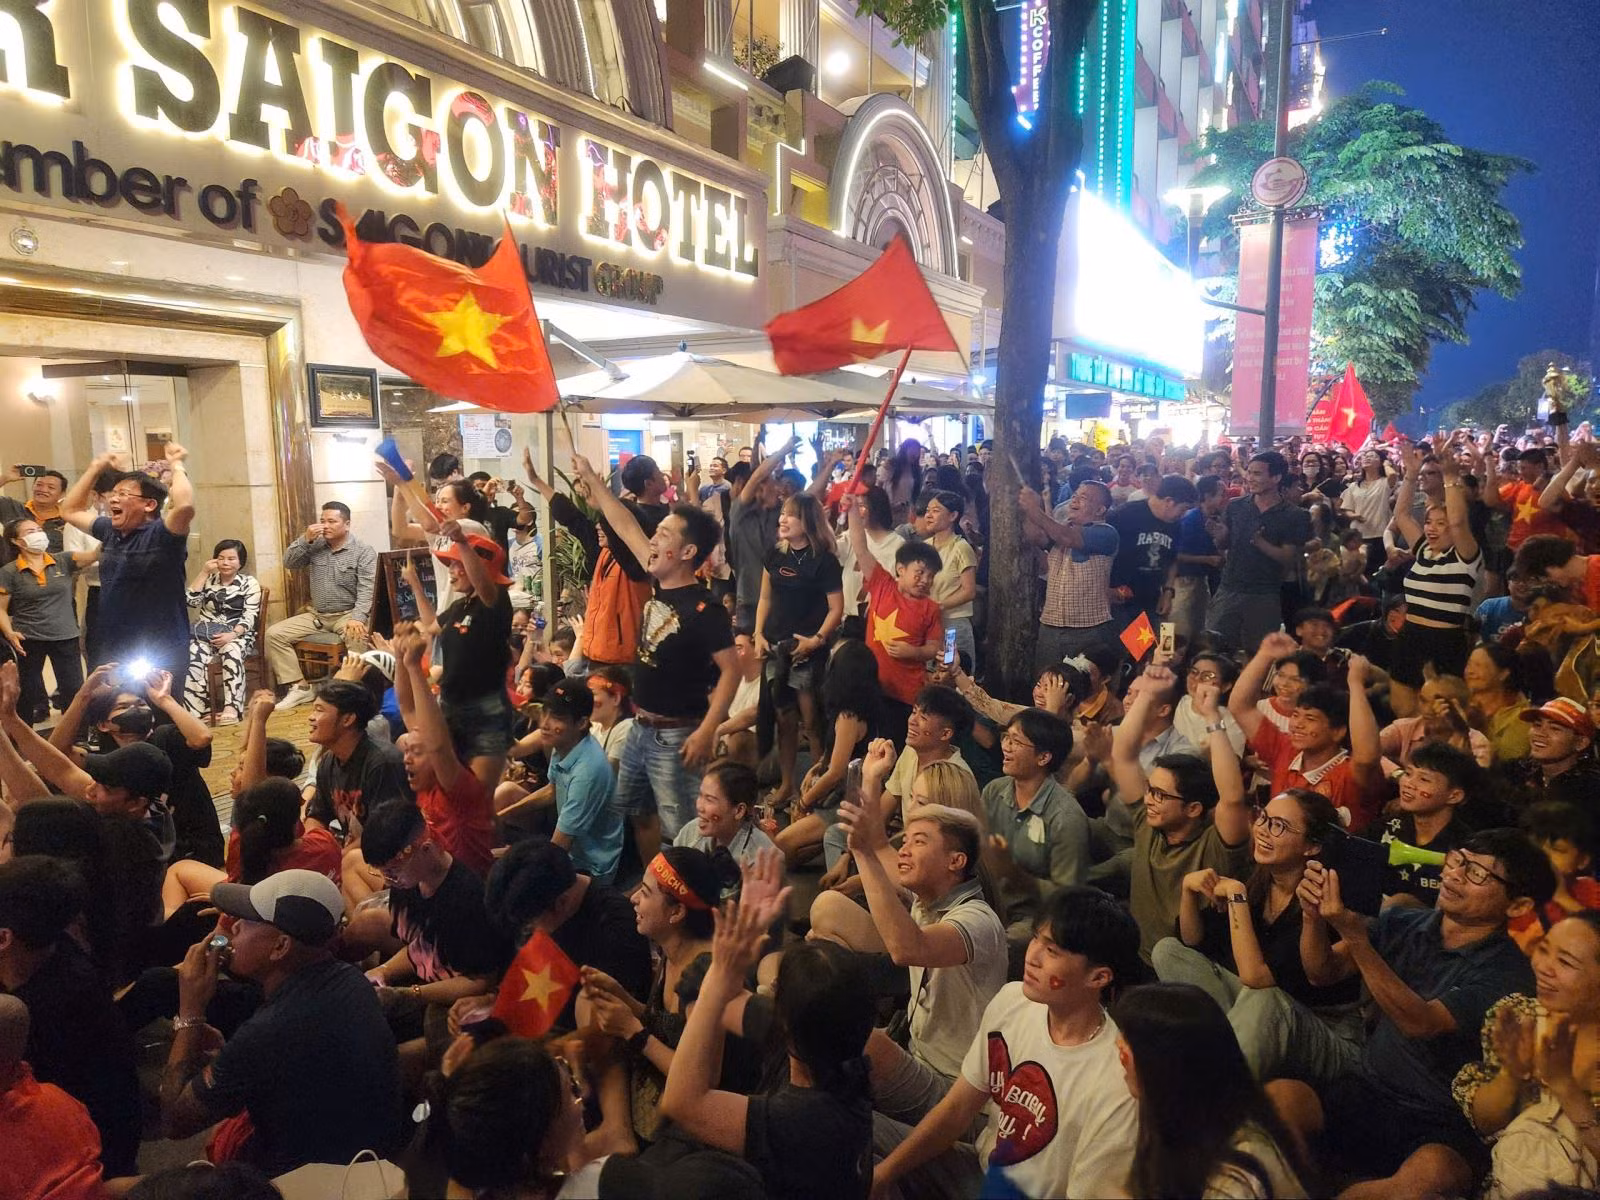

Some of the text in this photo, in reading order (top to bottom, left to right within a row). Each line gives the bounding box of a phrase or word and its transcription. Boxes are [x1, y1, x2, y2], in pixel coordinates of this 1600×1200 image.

[0, 140, 188, 215] mber
[199, 179, 258, 230] of
[129, 0, 560, 226] SAIGON
[585, 139, 759, 277] HOTEL
